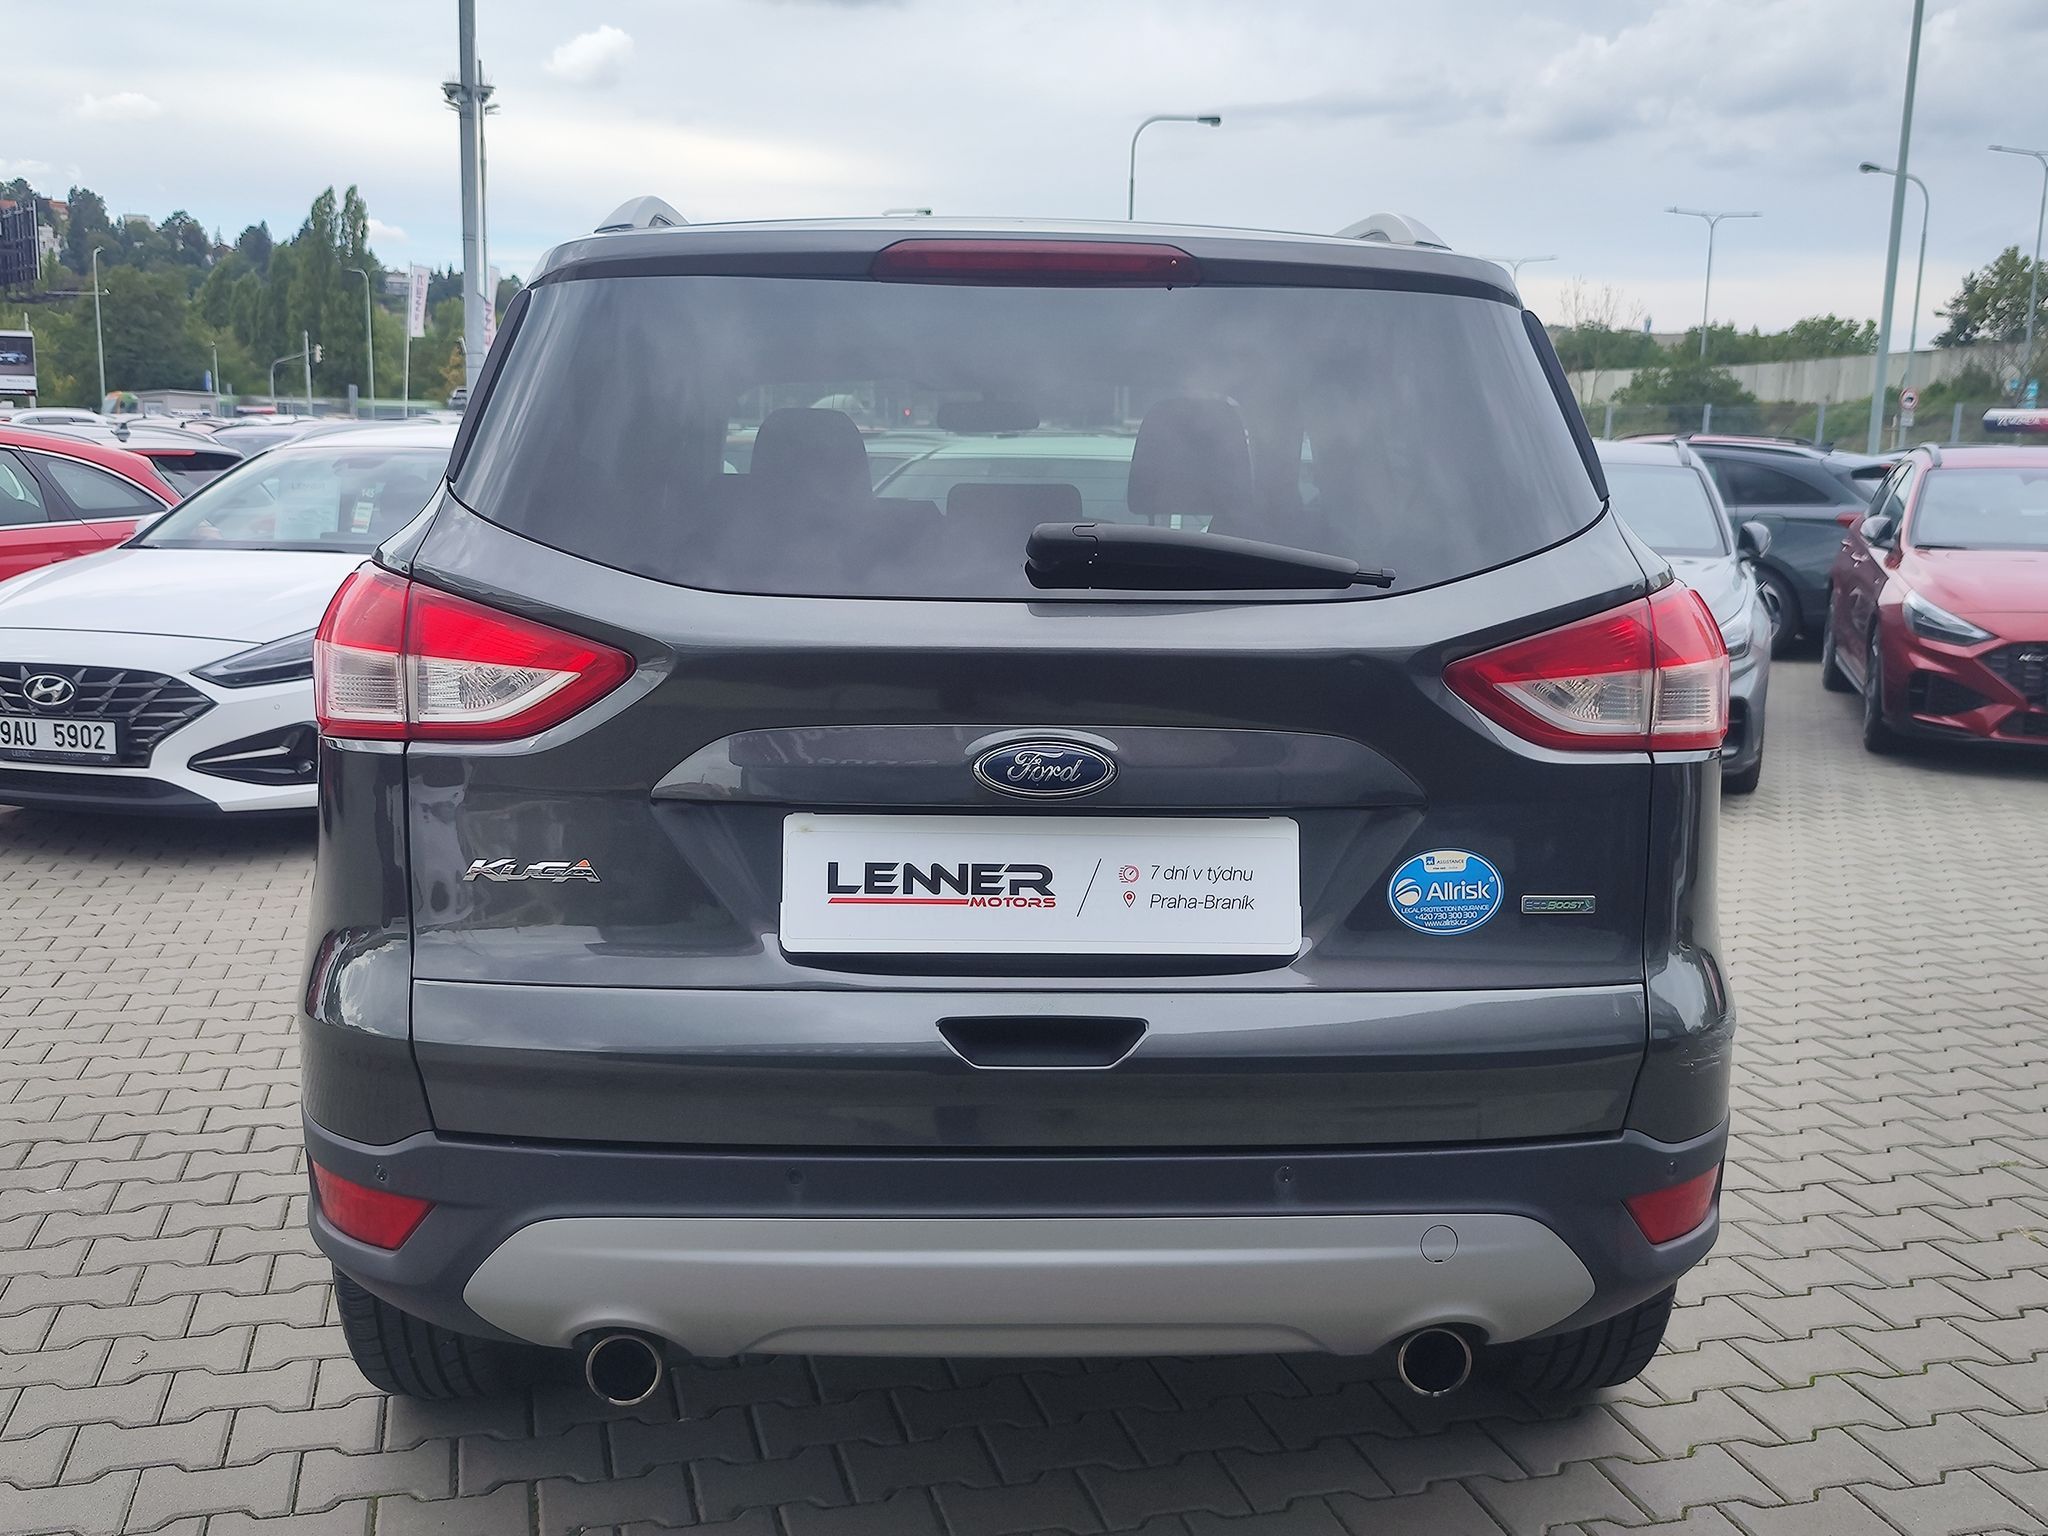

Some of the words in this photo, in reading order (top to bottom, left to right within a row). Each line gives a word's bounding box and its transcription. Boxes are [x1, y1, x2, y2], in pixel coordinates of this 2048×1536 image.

[0, 720, 37, 746] 9AU
[53, 723, 106, 750] 5902
[1007, 750, 1084, 782] Ford
[827, 861, 1057, 896] LENNER
[1151, 864, 1161, 880] 7
[1163, 865, 1191, 880] dní
[1193, 868, 1203, 880] v
[1207, 865, 1254, 885] týdnu
[1426, 880, 1491, 901] Allrisk
[969, 896, 1057, 908] MOTORS
[1149, 893, 1255, 910] Praha-Braník
[1434, 912, 1447, 920] 730
[1463, 911, 1478, 919] 300
